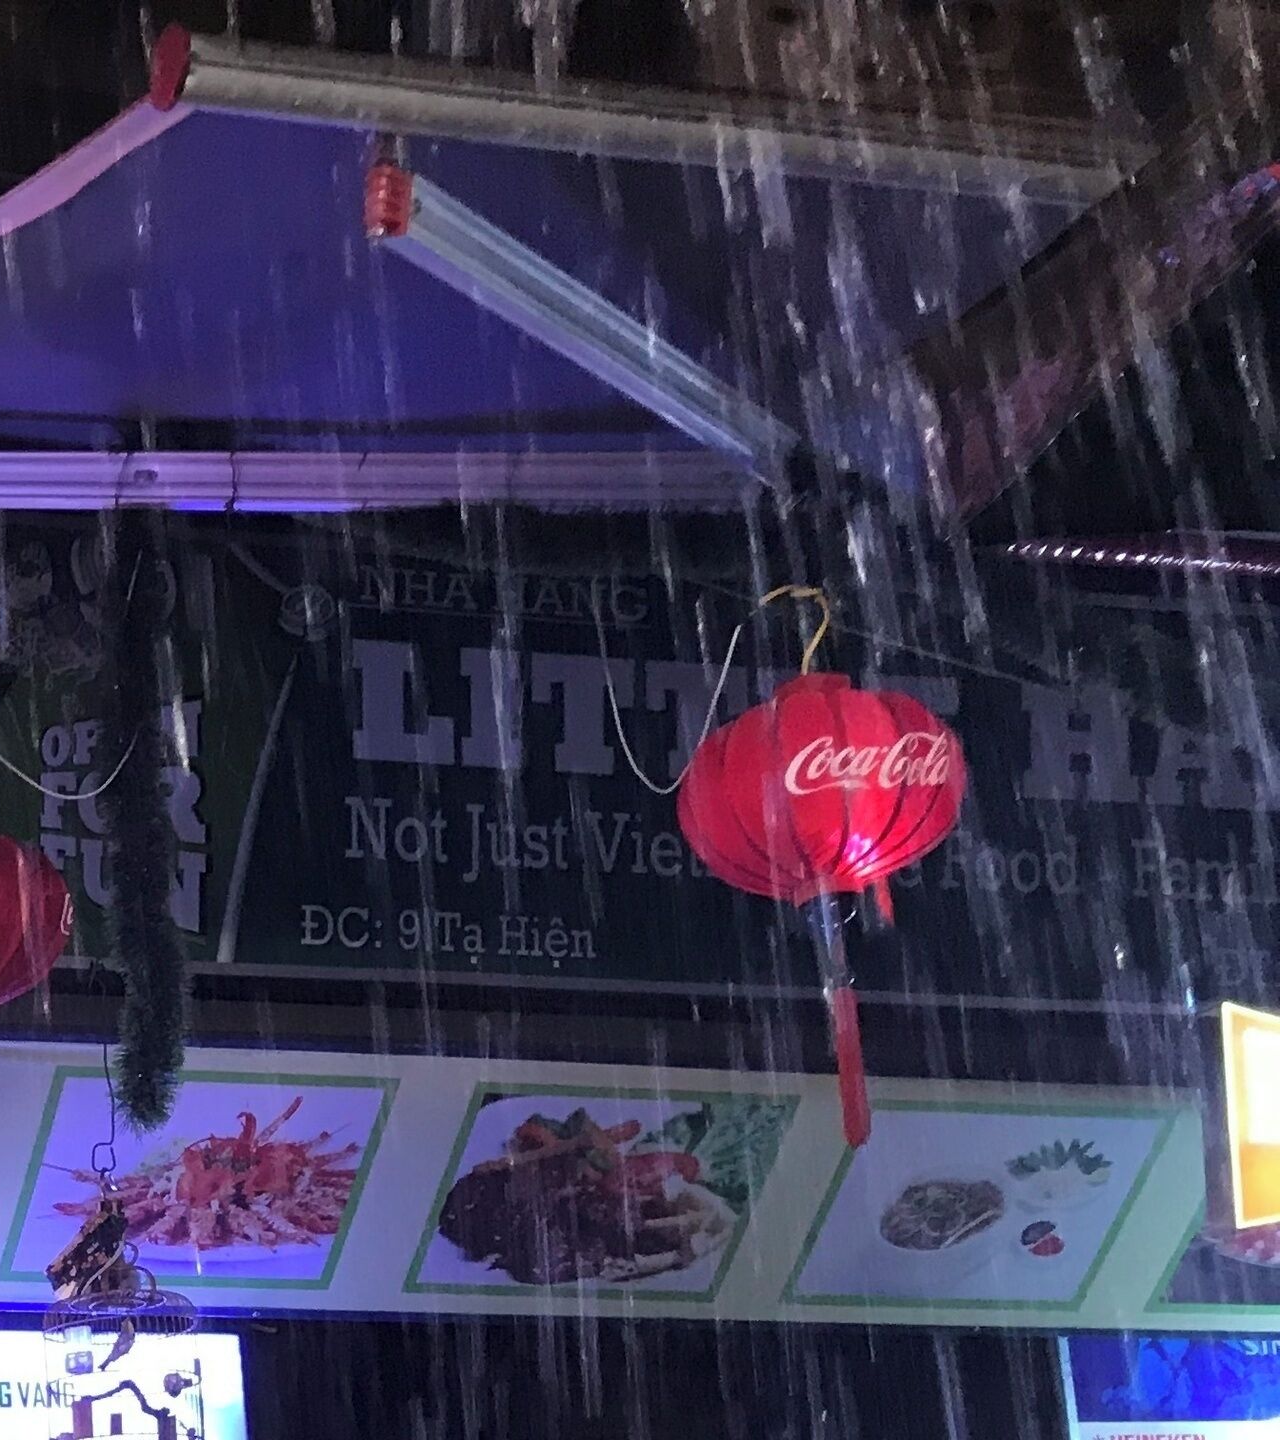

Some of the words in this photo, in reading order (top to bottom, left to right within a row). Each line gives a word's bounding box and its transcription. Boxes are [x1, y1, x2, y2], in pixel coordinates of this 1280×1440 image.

[785, 732, 949, 794] Coca-Cola
[345, 798, 448, 862] Not
[463, 804, 569, 881] Just
[301, 904, 382, 948] ĐC:
[499, 916, 596, 967] Hiện
